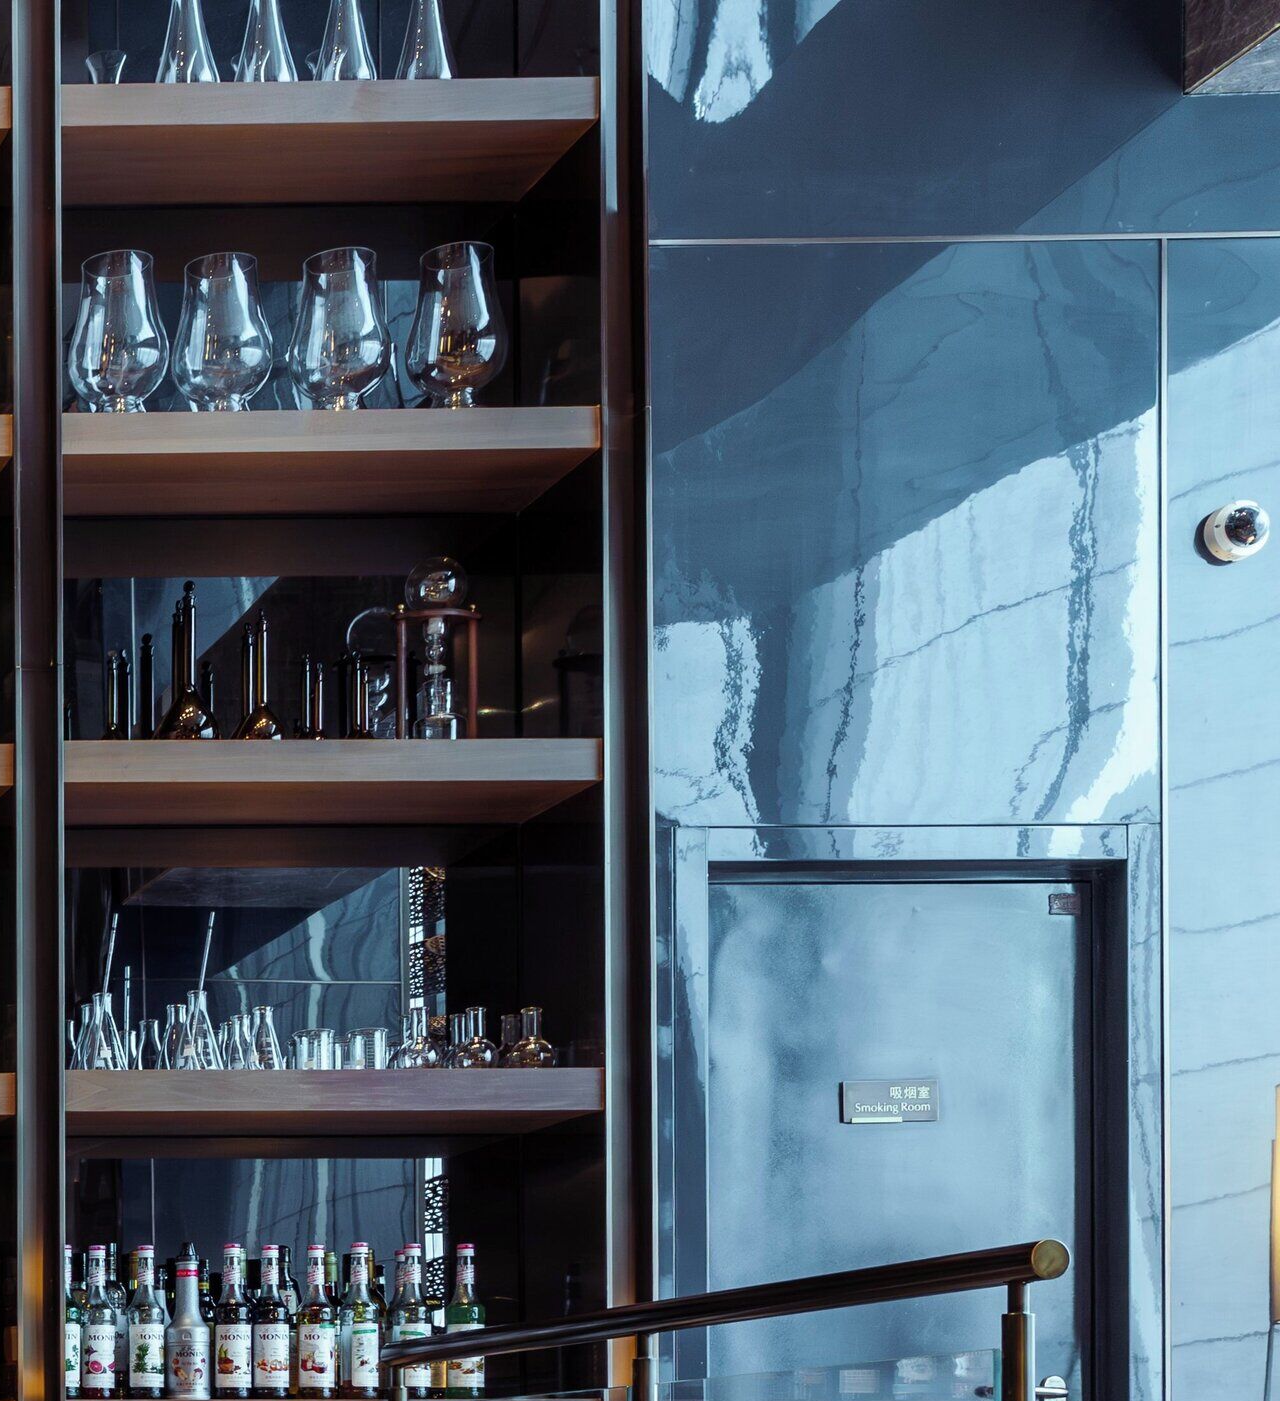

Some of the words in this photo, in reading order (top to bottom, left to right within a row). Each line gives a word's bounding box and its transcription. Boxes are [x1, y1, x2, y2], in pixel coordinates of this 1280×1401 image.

[889, 1086, 931, 1099] 吸烟室
[855, 1102, 899, 1115] Smoking
[901, 1102, 931, 1112] Room
[176, 1350, 204, 1358] MONIN
